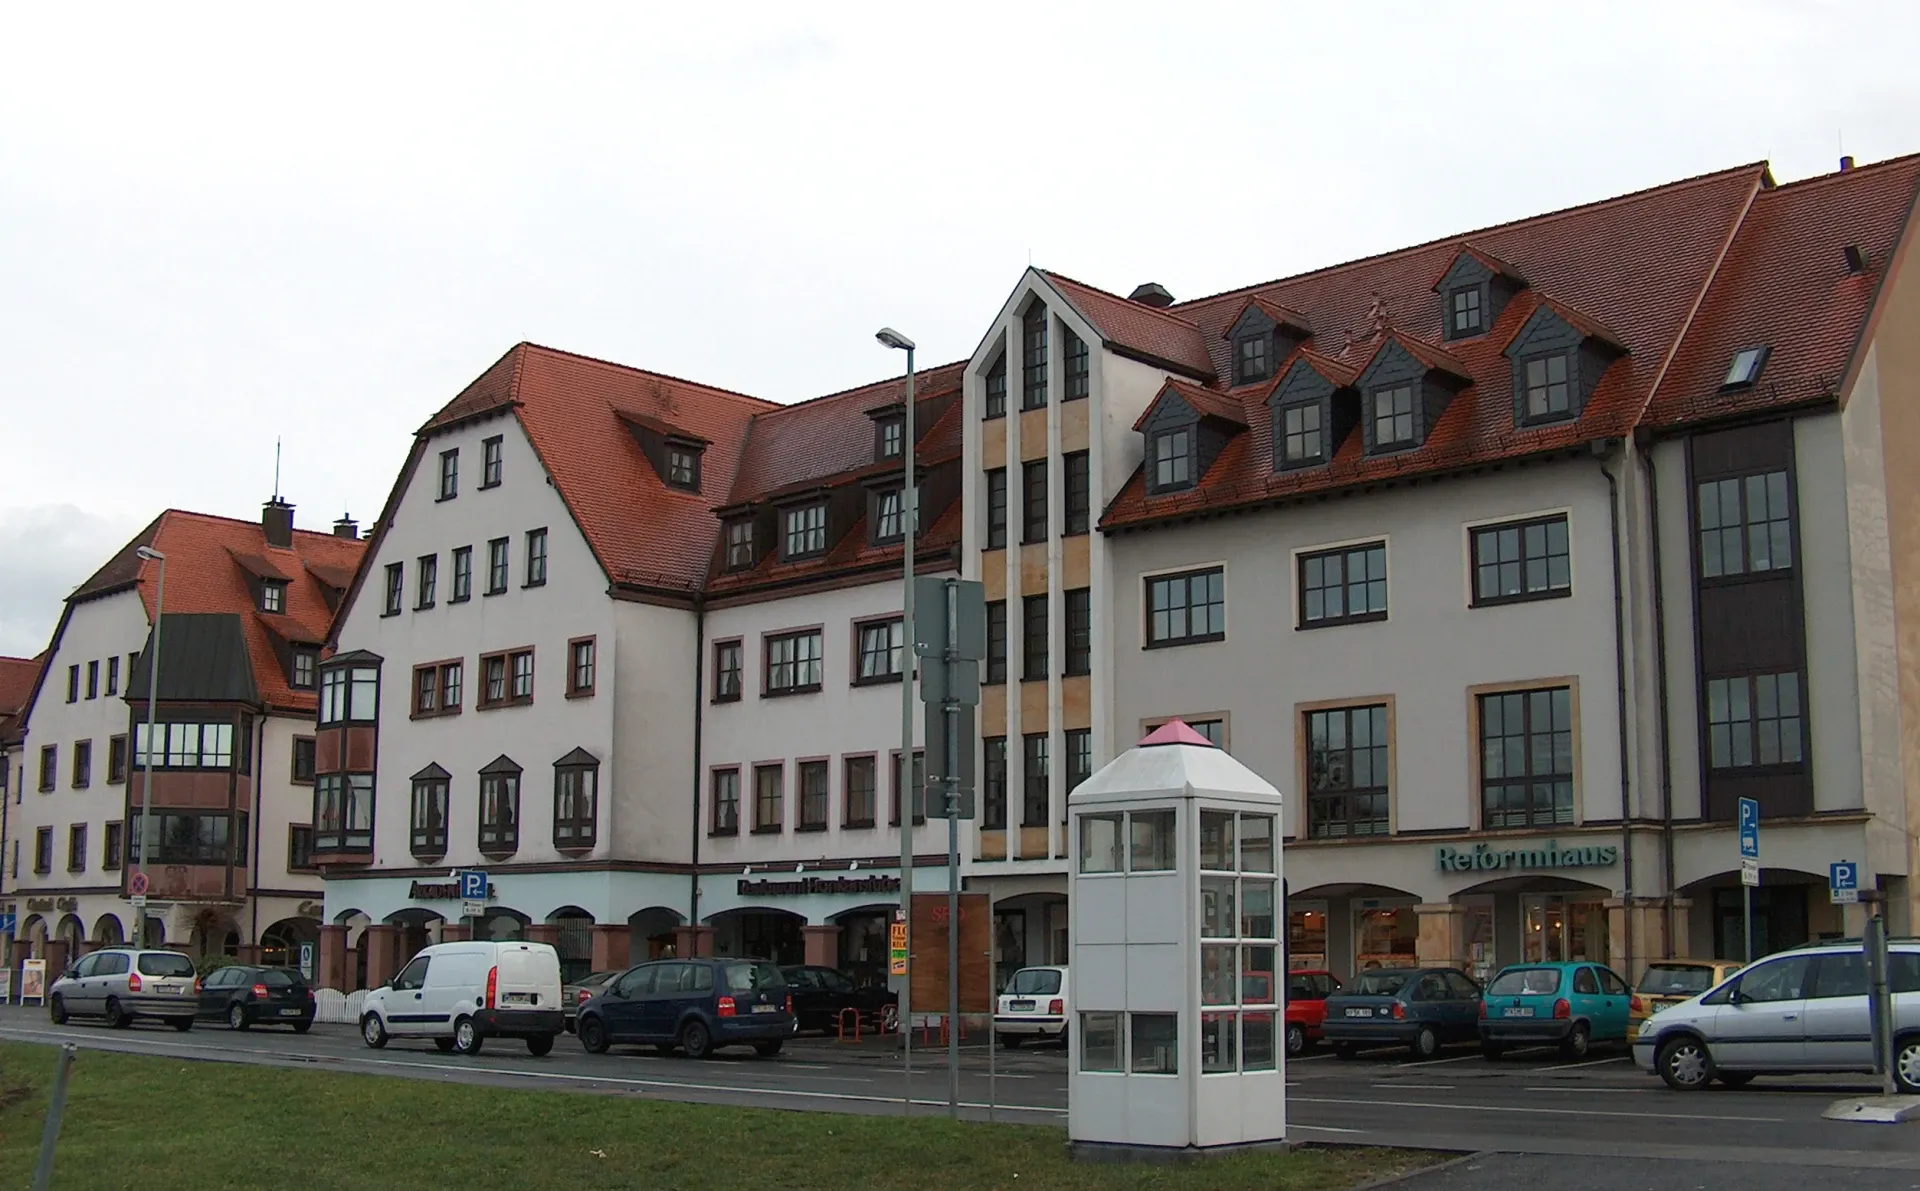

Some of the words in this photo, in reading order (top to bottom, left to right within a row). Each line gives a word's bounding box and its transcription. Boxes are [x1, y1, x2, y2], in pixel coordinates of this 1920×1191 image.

[1742, 803, 1751, 826] P
[1434, 839, 1617, 872] Reformhaus
[467, 874, 481, 896] P
[1836, 866, 1850, 888] P
